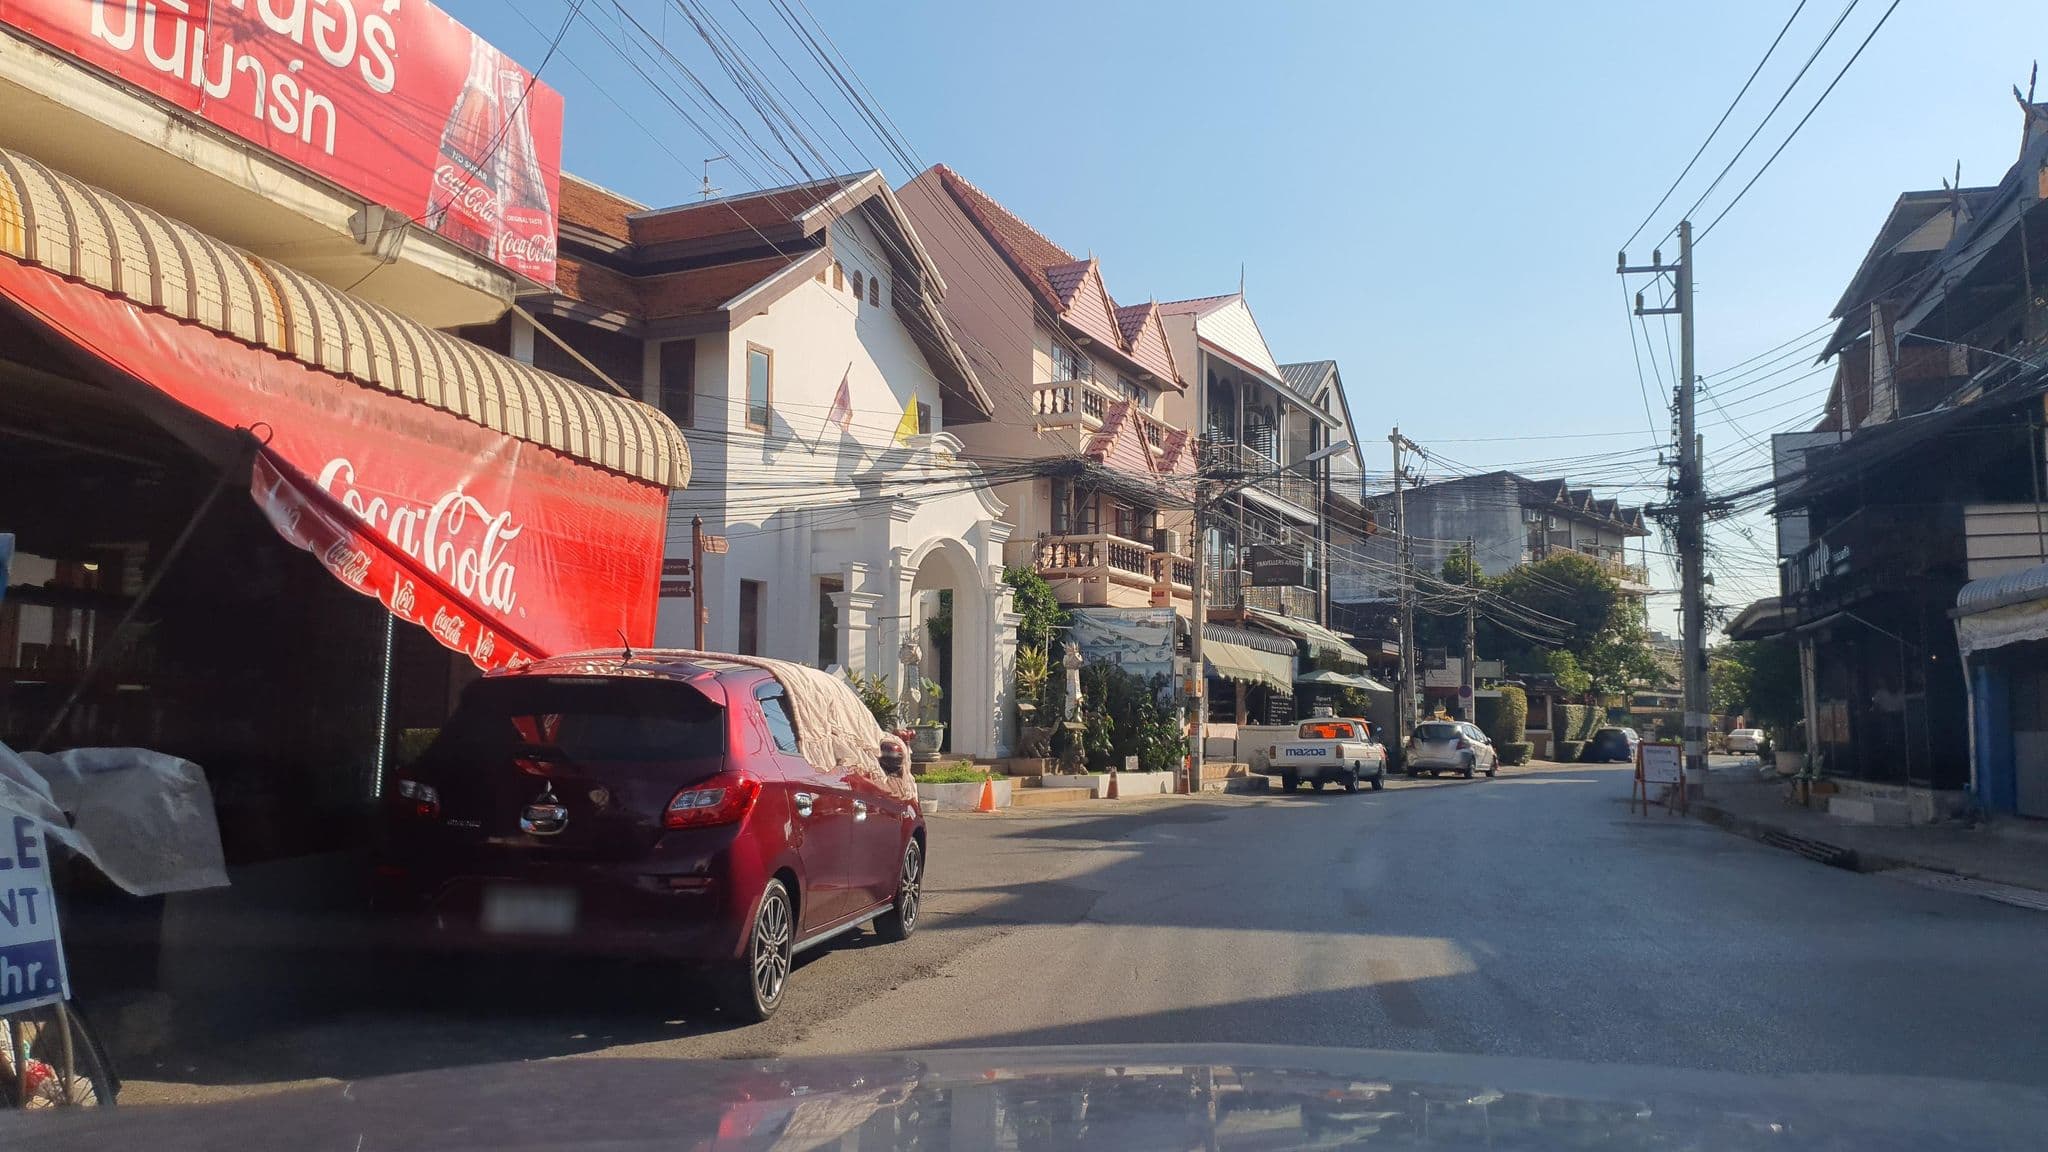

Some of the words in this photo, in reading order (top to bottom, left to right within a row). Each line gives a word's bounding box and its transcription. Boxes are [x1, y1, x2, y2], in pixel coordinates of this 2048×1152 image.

[434, 165, 499, 222] Coca-Cola
[500, 231, 556, 262] Coca-Cola
[325, 537, 373, 585] Coca-Cola
[1787, 537, 1829, 591] Tringle
[432, 605, 466, 646] Coca-Cola
[1286, 748, 1327, 756] mazda
